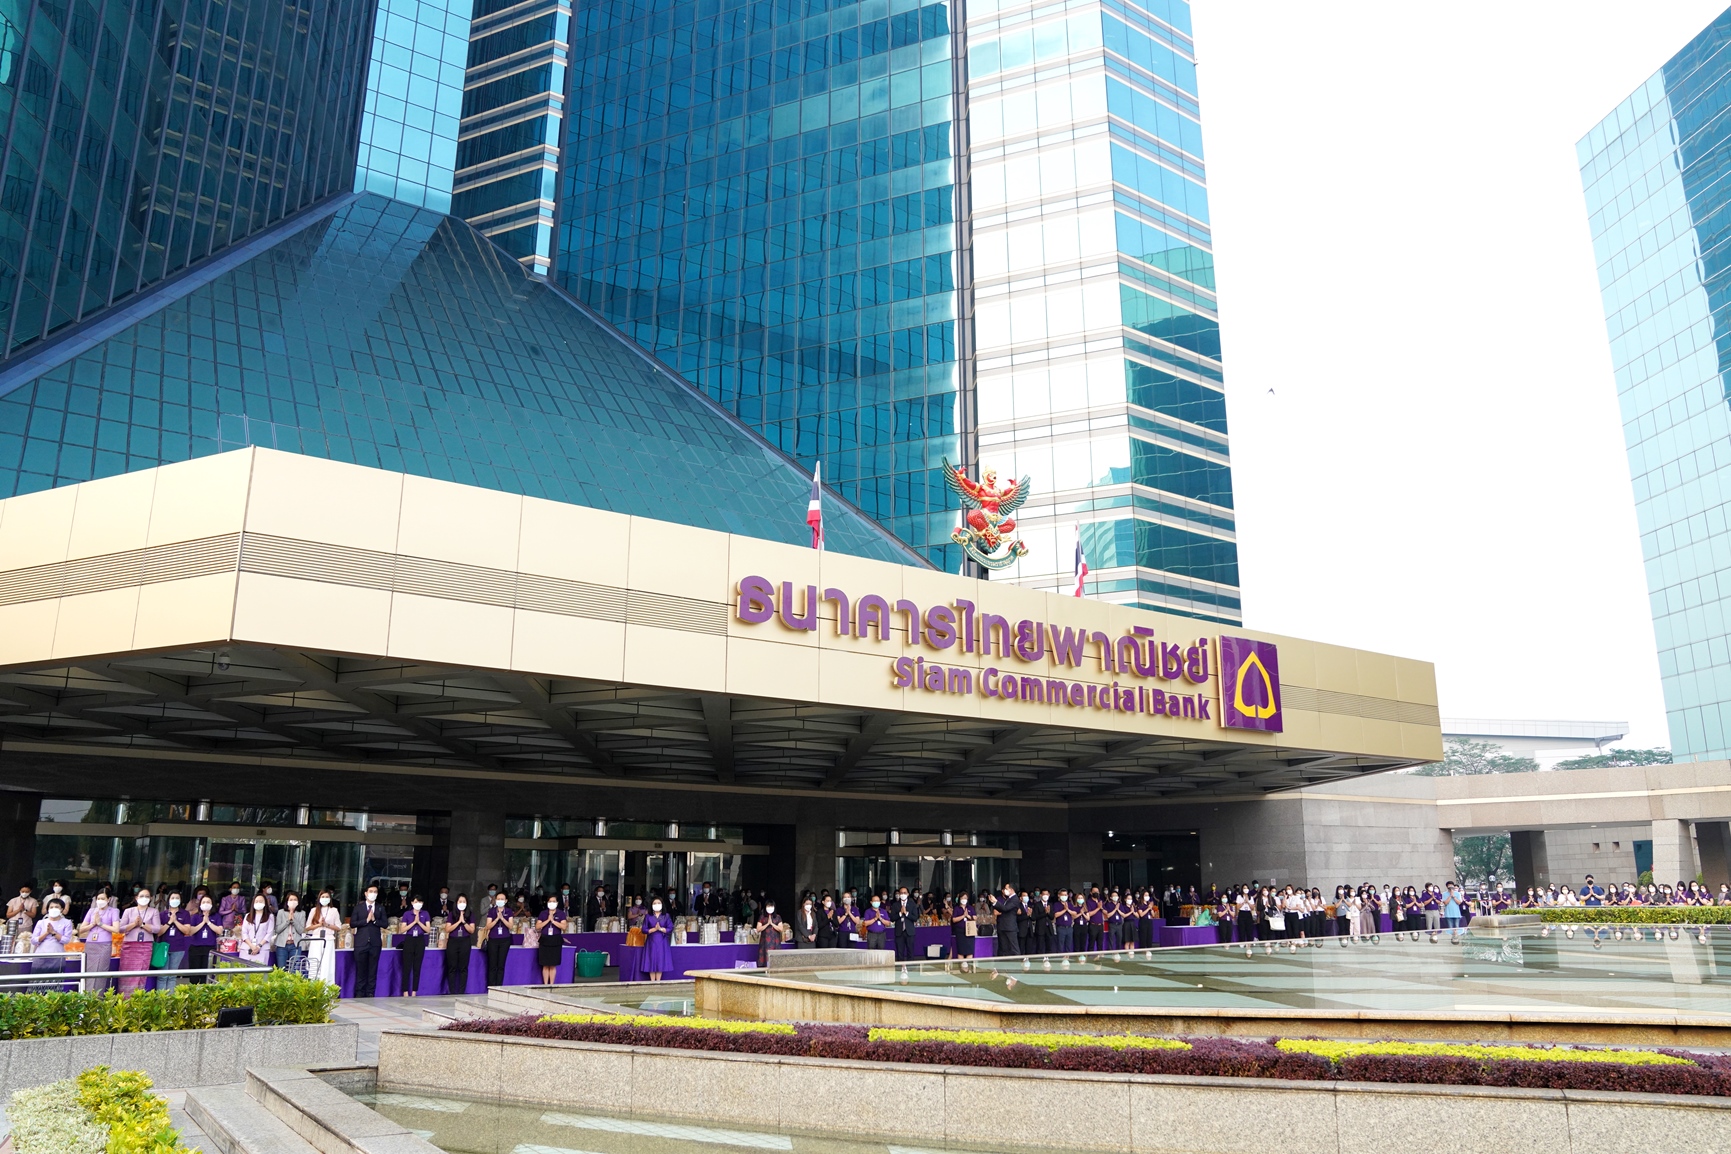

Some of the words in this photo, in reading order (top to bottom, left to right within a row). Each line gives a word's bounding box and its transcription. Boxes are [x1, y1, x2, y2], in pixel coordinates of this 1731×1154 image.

[736, 575, 1209, 684] ธนาคารไทยพาณิชย์
[893, 656, 973, 694] Siam
[979, 667, 1145, 714] Commercial
[1149, 688, 1211, 721] Bank
